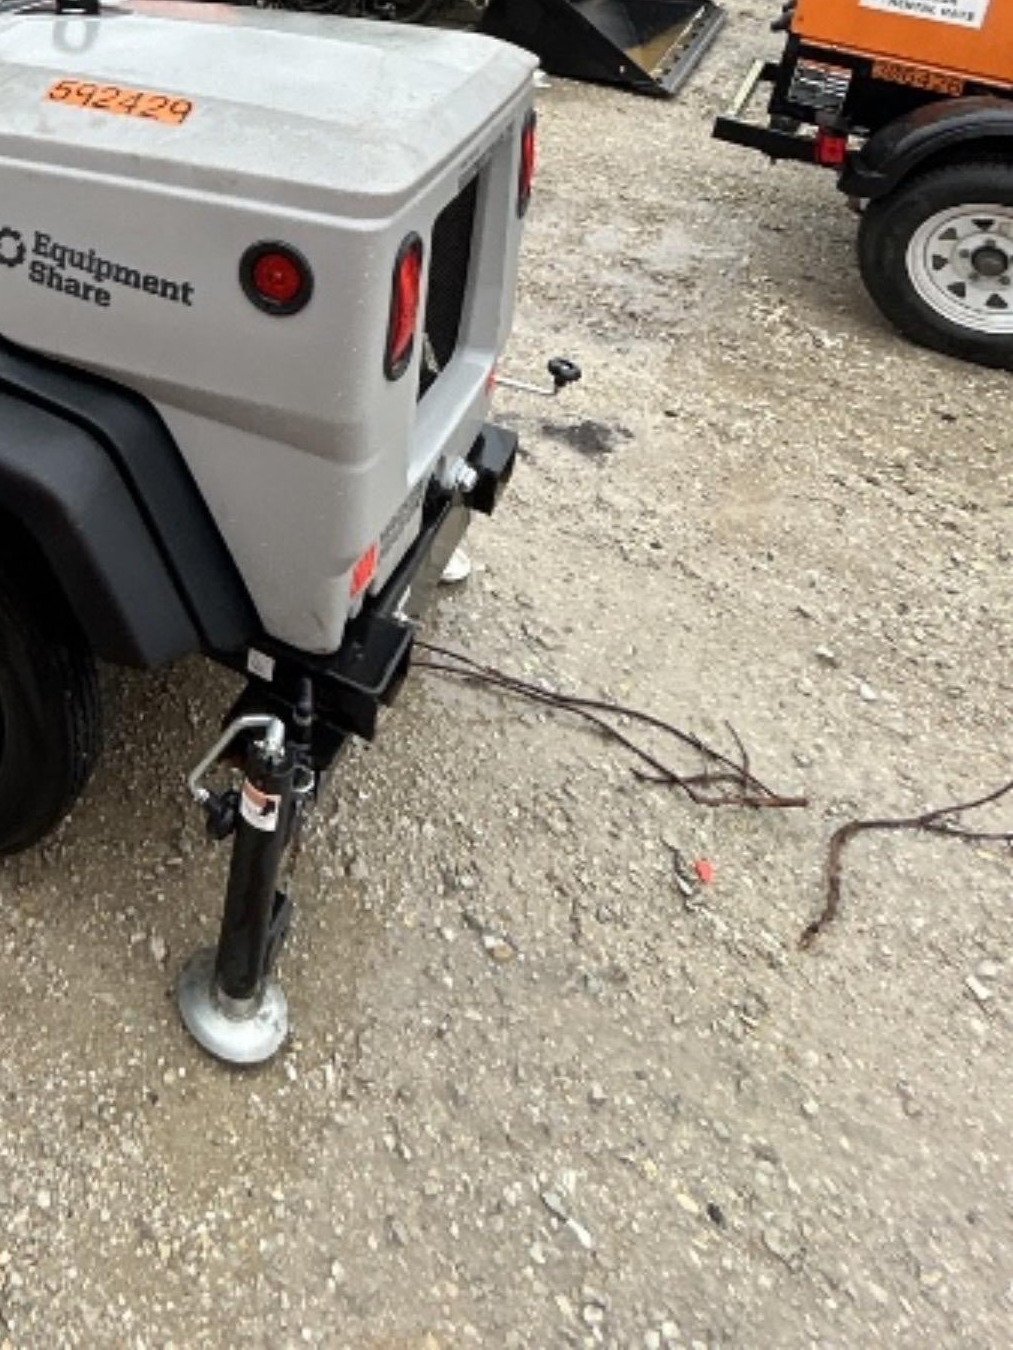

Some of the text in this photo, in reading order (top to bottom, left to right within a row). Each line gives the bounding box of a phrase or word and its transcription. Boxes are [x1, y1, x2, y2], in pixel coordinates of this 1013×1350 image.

[49, 80, 193, 124] 592429
[28, 260, 112, 307] Share
[32, 230, 195, 306] Equipment
